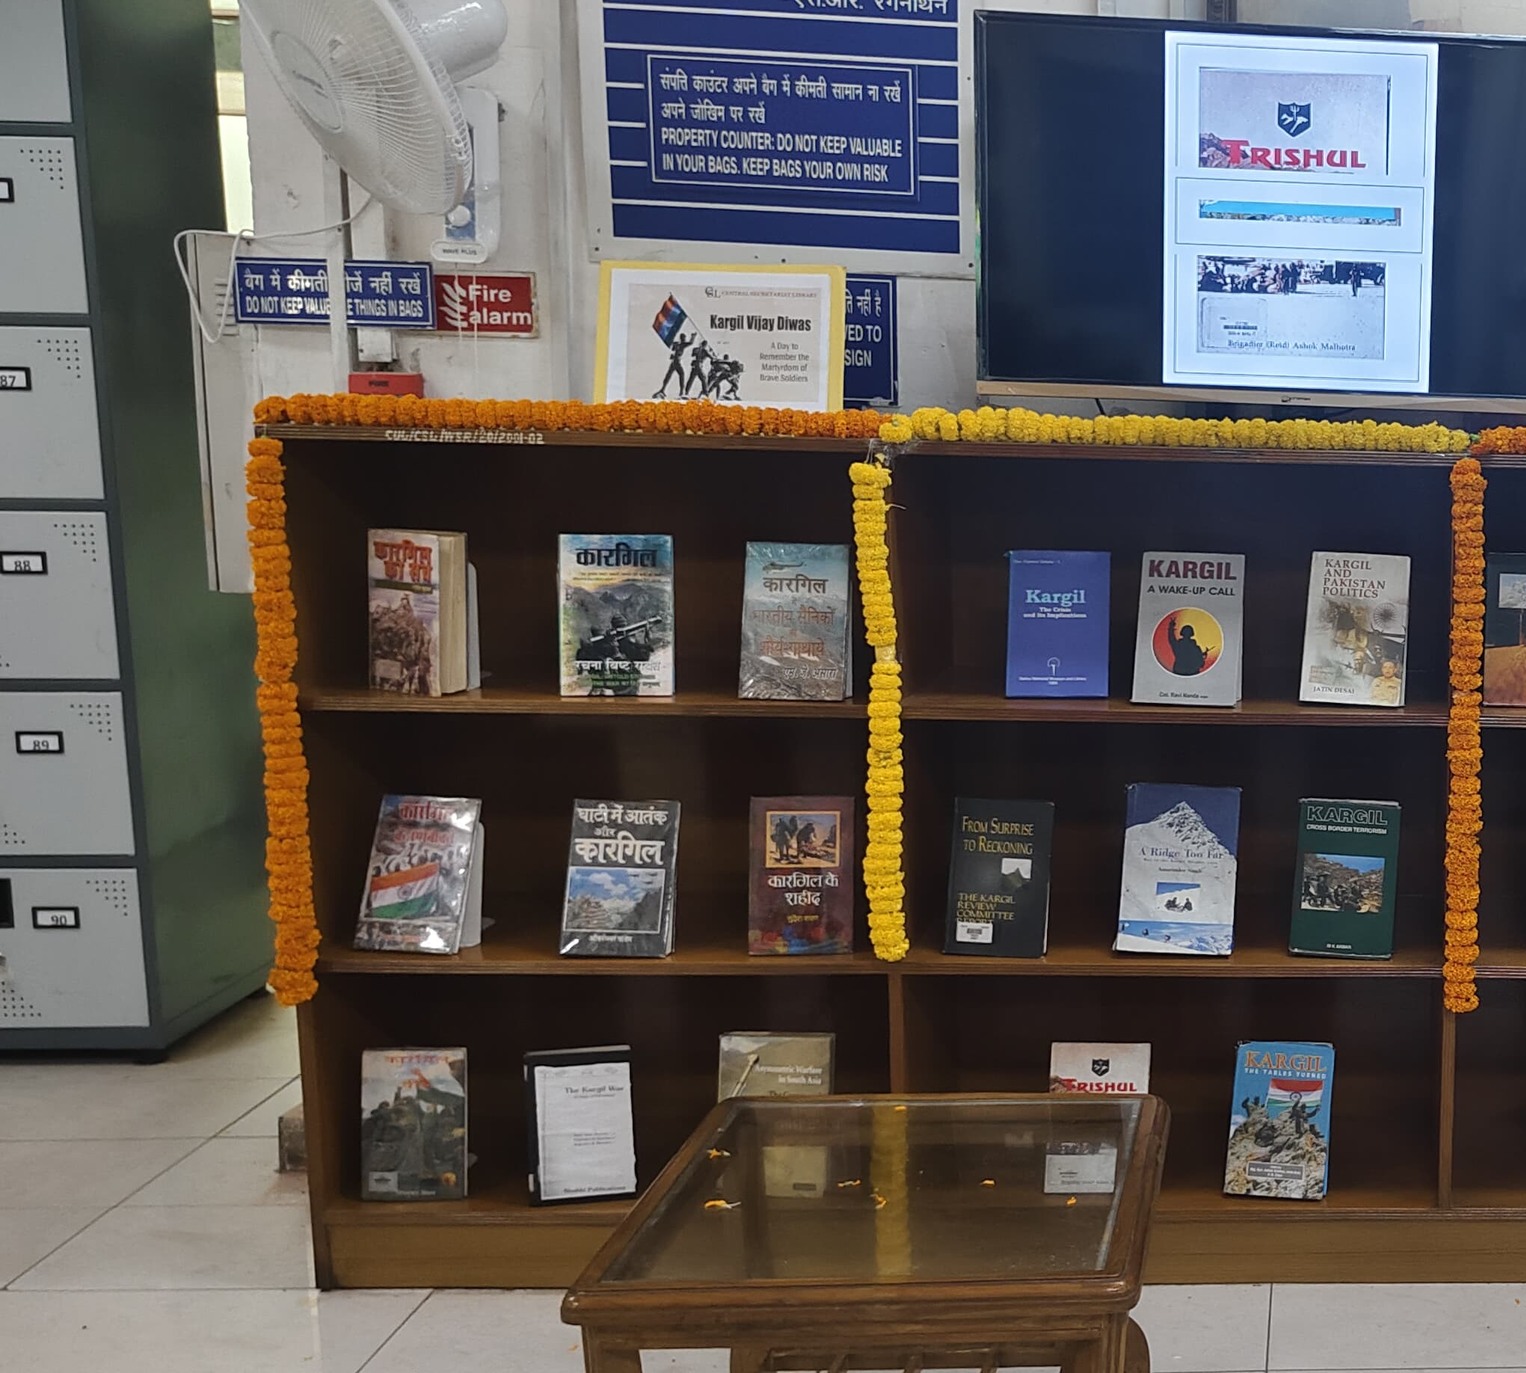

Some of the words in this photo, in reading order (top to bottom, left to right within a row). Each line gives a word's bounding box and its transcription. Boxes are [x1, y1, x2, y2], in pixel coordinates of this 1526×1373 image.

[693, 69, 728, 94] काउंटर
[733, 73, 757, 95] अपने
[762, 74, 777, 96] बैग
[782, 74, 790, 96] में
[796, 74, 827, 98] कीमती
[832, 82, 863, 100] सामान
[868, 84, 878, 101] ना
[885, 80, 901, 103] रखें
[662, 99, 686, 120] अपने
[692, 99, 725, 122] जोखिम
[731, 106, 743, 122] पर
[749, 102, 766, 124] रखें
[661, 128, 718, 149] PROPERTY
[721, 130, 775, 150] COUNTER:
[777, 134, 793, 151] DO
[795, 135, 817, 152] NOT
[819, 136, 847, 154] KEEP
[850, 138, 902, 157] VALUABLE
[1220, 140, 1366, 168] TRISHUL
[663, 153, 673, 170] IN
[674, 154, 706, 173] YOUR
[708, 156, 740, 174] BAGS.
[742, 158, 770, 176] KEEP
[772, 159, 802, 177] BAGS
[803, 161, 834, 179] YOUR
[836, 162, 861, 181] OWN
[863, 163, 889, 182] RISK
[245, 267, 264, 291] बैग
[270, 269, 281, 291] में
[287, 269, 328, 293] कीमती
[369, 272, 393, 295] नहीं
[400, 271, 421, 295] रखें
[468, 284, 512, 303] Fire
[246, 295, 259, 313] DO
[260, 296, 279, 314] NOT
[281, 296, 304, 314] KEEP
[354, 299, 387, 317] THINGS
[389, 300, 397, 317] IN
[399, 301, 424, 318] BAGS
[856, 289, 871, 316] नहीं
[874, 289, 881, 317] है
[469, 309, 532, 326] alarm
[710, 314, 744, 331] Kargil
[746, 315, 774, 333] Vijay
[778, 317, 812, 332] Diwas
[866, 325, 882, 342] TO
[770, 342, 776, 350] A
[777, 342, 790, 352] Day
[1321, 342, 1356, 351] Malhotra
[760, 353, 796, 361] Remember
[798, 353, 810, 361] the
[845, 349, 871, 366] SIGN
[762, 363, 799, 373] Martyrdom
[800, 364, 808, 372] of
[760, 374, 778, 382] Brave
[780, 374, 808, 383] Soldiers
[575, 542, 657, 567] कारगिल
[1148, 559, 1237, 580] KARGIL
[1325, 559, 1372, 570] KARGIL
[1324, 569, 1351, 578] AND
[763, 574, 828, 594] कारगिल
[1147, 585, 1155, 593] A
[1159, 585, 1205, 595] WAKE-UP
[1209, 587, 1235, 596] CALL
[1323, 577, 1386, 590] PAKISTAN
[1025, 589, 1086, 607] Kargil
[1323, 587, 1379, 598] POLITICS
[33, 740, 50, 751] 89
[577, 803, 608, 823] घाटी
[610, 804, 624, 824] में
[625, 806, 669, 825] आतंक
[1307, 806, 1388, 825] KARGIL
[594, 825, 616, 837] और
[962, 816, 987, 833] FROM
[991, 818, 1034, 836] SURPRISE
[1353, 826, 1387, 835] TERRORISM
[574, 831, 666, 865] कारगिल
[963, 839, 976, 851] TO
[979, 836, 1033, 855] RECKONING
[1151, 847, 1180, 858] Ridge
[1184, 849, 1203, 858] Too
[1207, 849, 1224, 859] Far
[768, 872, 822, 888] कारगिल
[825, 872, 838, 887] के
[785, 891, 821, 906] शहीद
[957, 901, 997, 911] REVIEW
[958, 893, 978, 901] THE
[980, 894, 1016, 904] KARGIL
[51, 915, 67, 926] 90
[957, 909, 1015, 920] COMMITTEE
[1244, 1051, 1327, 1072] KARGIL
[1263, 1069, 1292, 1077] TABLES
[1060, 1078, 1137, 1092] TRISHUL
